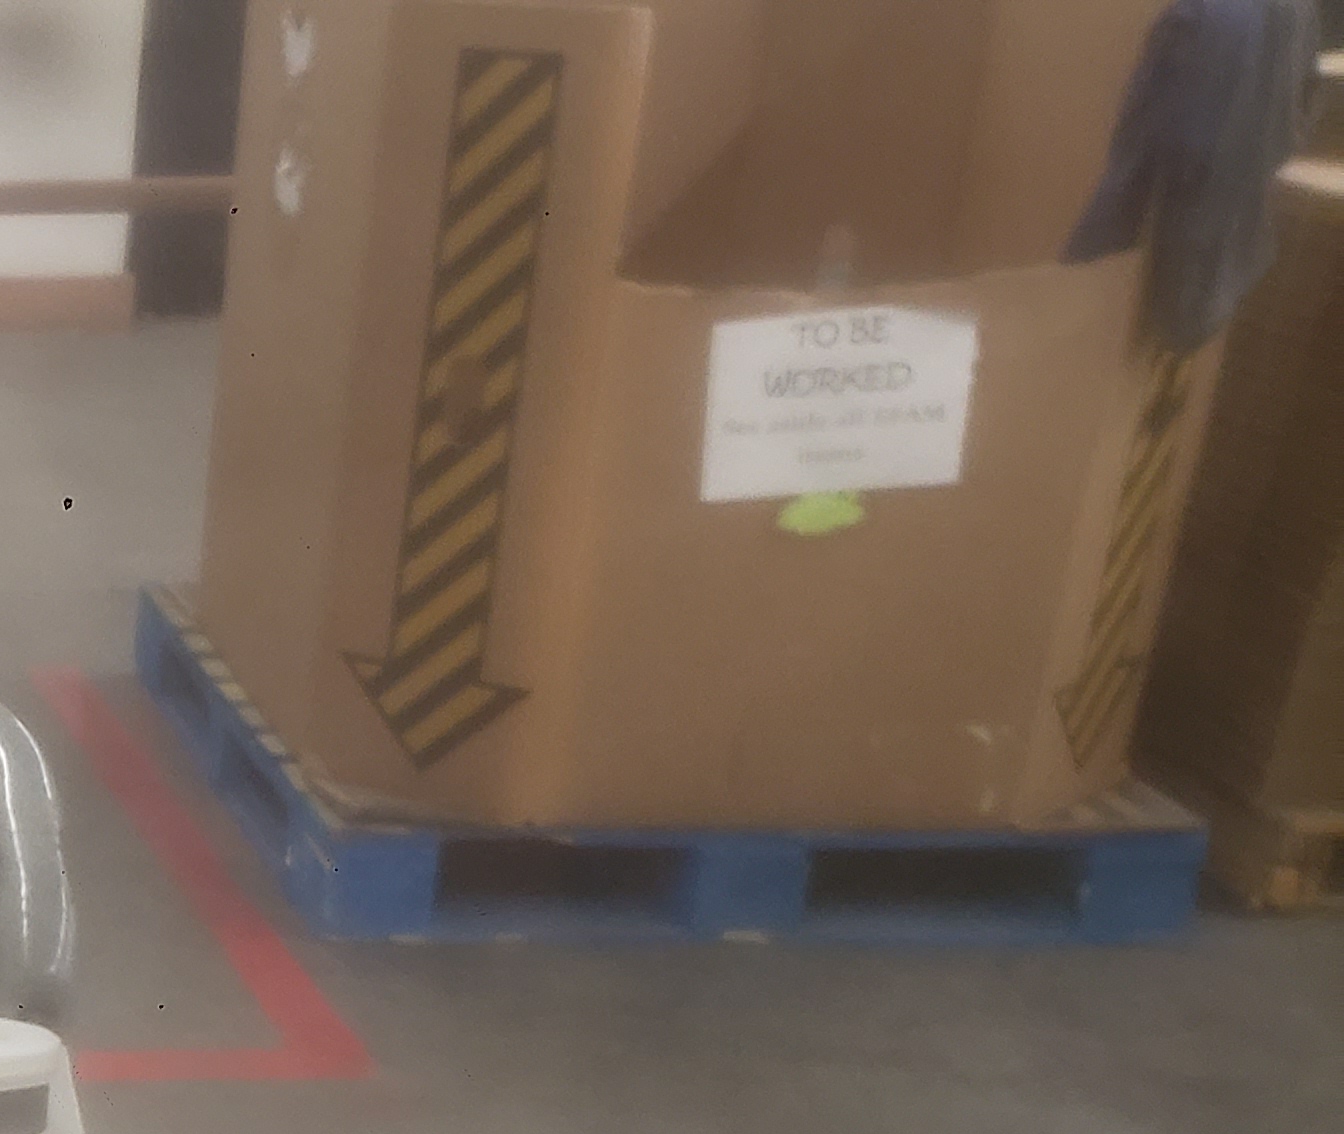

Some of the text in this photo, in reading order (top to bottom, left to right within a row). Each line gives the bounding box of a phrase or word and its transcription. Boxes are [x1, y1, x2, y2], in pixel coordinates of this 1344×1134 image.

[791, 314, 890, 349] TO BE
[764, 361, 914, 399] WORKED
